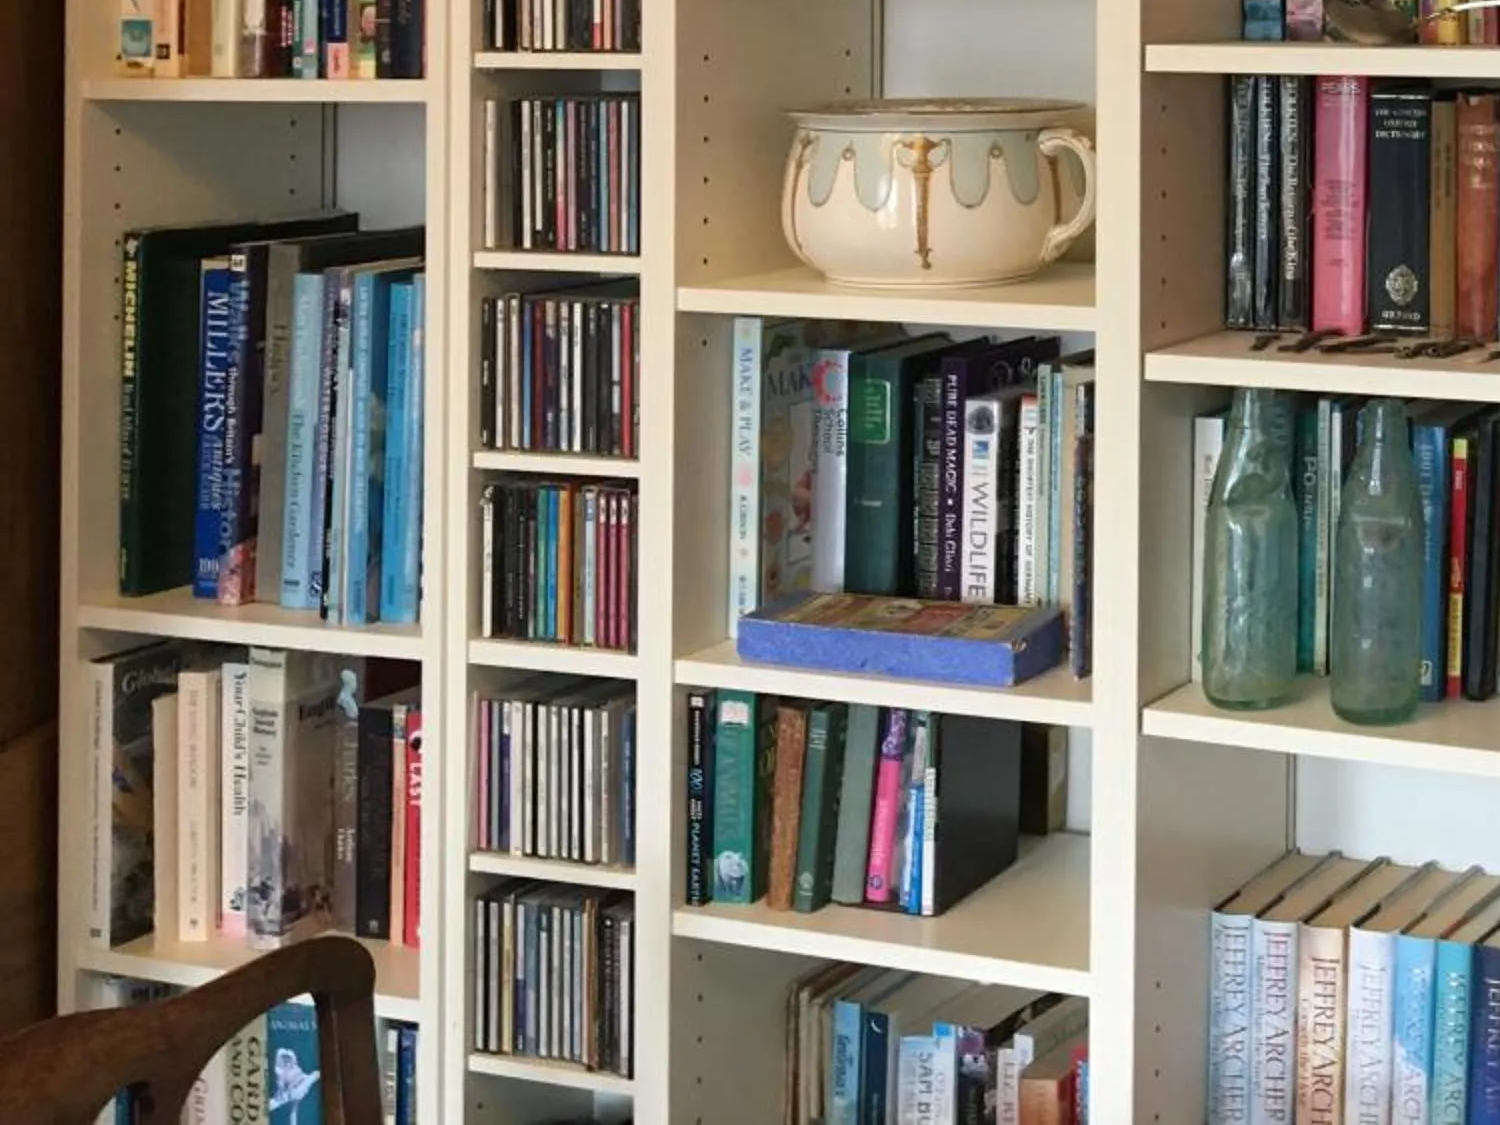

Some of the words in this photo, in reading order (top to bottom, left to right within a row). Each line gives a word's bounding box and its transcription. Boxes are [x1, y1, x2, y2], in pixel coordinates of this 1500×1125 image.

[123, 261, 138, 378] MICHELIN
[226, 279, 250, 364] Walks
[225, 367, 238, 415] through
[738, 348, 754, 396] MAKE
[944, 374, 958, 406] PURE
[291, 414, 306, 439] The
[738, 399, 753, 411] &
[823, 408, 835, 454] School
[944, 410, 958, 446] DEAD
[224, 417, 237, 465] Britain's
[737, 414, 752, 456] PLAY
[289, 442, 305, 499] Kitchen
[944, 447, 958, 492] MAGIC
[216, 467, 243, 559] History
[286, 500, 302, 569] Gardener
[969, 482, 991, 597] WILDLIFE
[232, 671, 248, 709] Your
[232, 710, 247, 761] Child's
[232, 764, 247, 816] Health
[690, 822, 702, 865] PLANET
[1220, 925, 1250, 1017] JEFFREY
[1262, 930, 1291, 1020] JEFFREY
[1311, 957, 1340, 1049] JEFFREY
[1359, 965, 1385, 1048] JEFFREY
[1404, 966, 1427, 1055] JEFFREY
[1445, 970, 1467, 1063] JEFFREY
[246, 1036, 261, 1123] GARD
[917, 1051, 934, 1094] SAM
[1221, 1024, 1253, 1122] ARCHER
[1263, 1027, 1291, 1122] ARCHER
